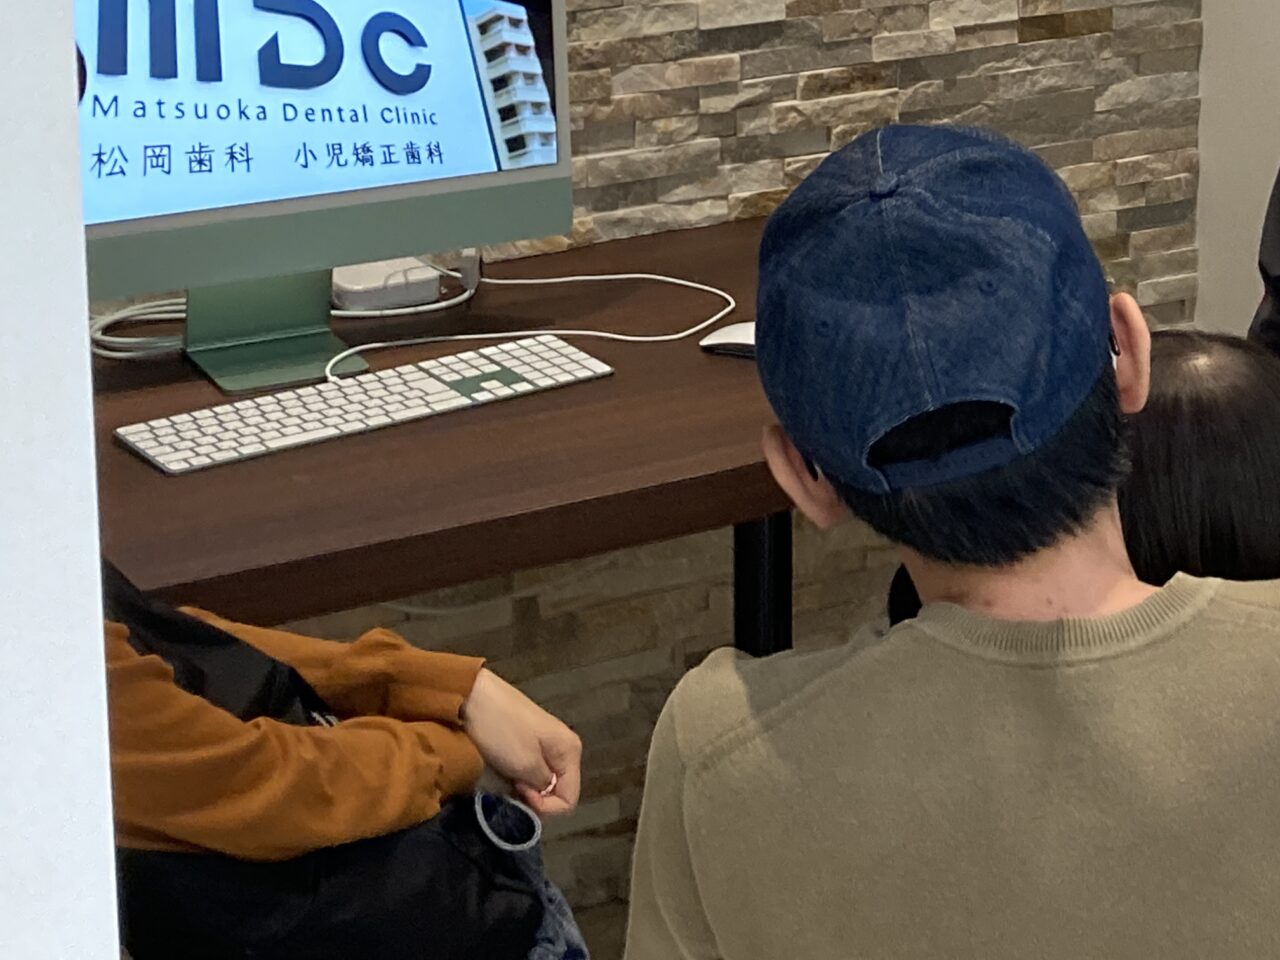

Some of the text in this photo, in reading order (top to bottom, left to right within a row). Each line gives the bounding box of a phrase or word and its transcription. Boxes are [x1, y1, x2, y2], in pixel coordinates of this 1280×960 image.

[91, 94, 438, 126] Matsuoka Dental Clinic
[89, 140, 444, 179] 松岡歯科 小児矯正歯科
